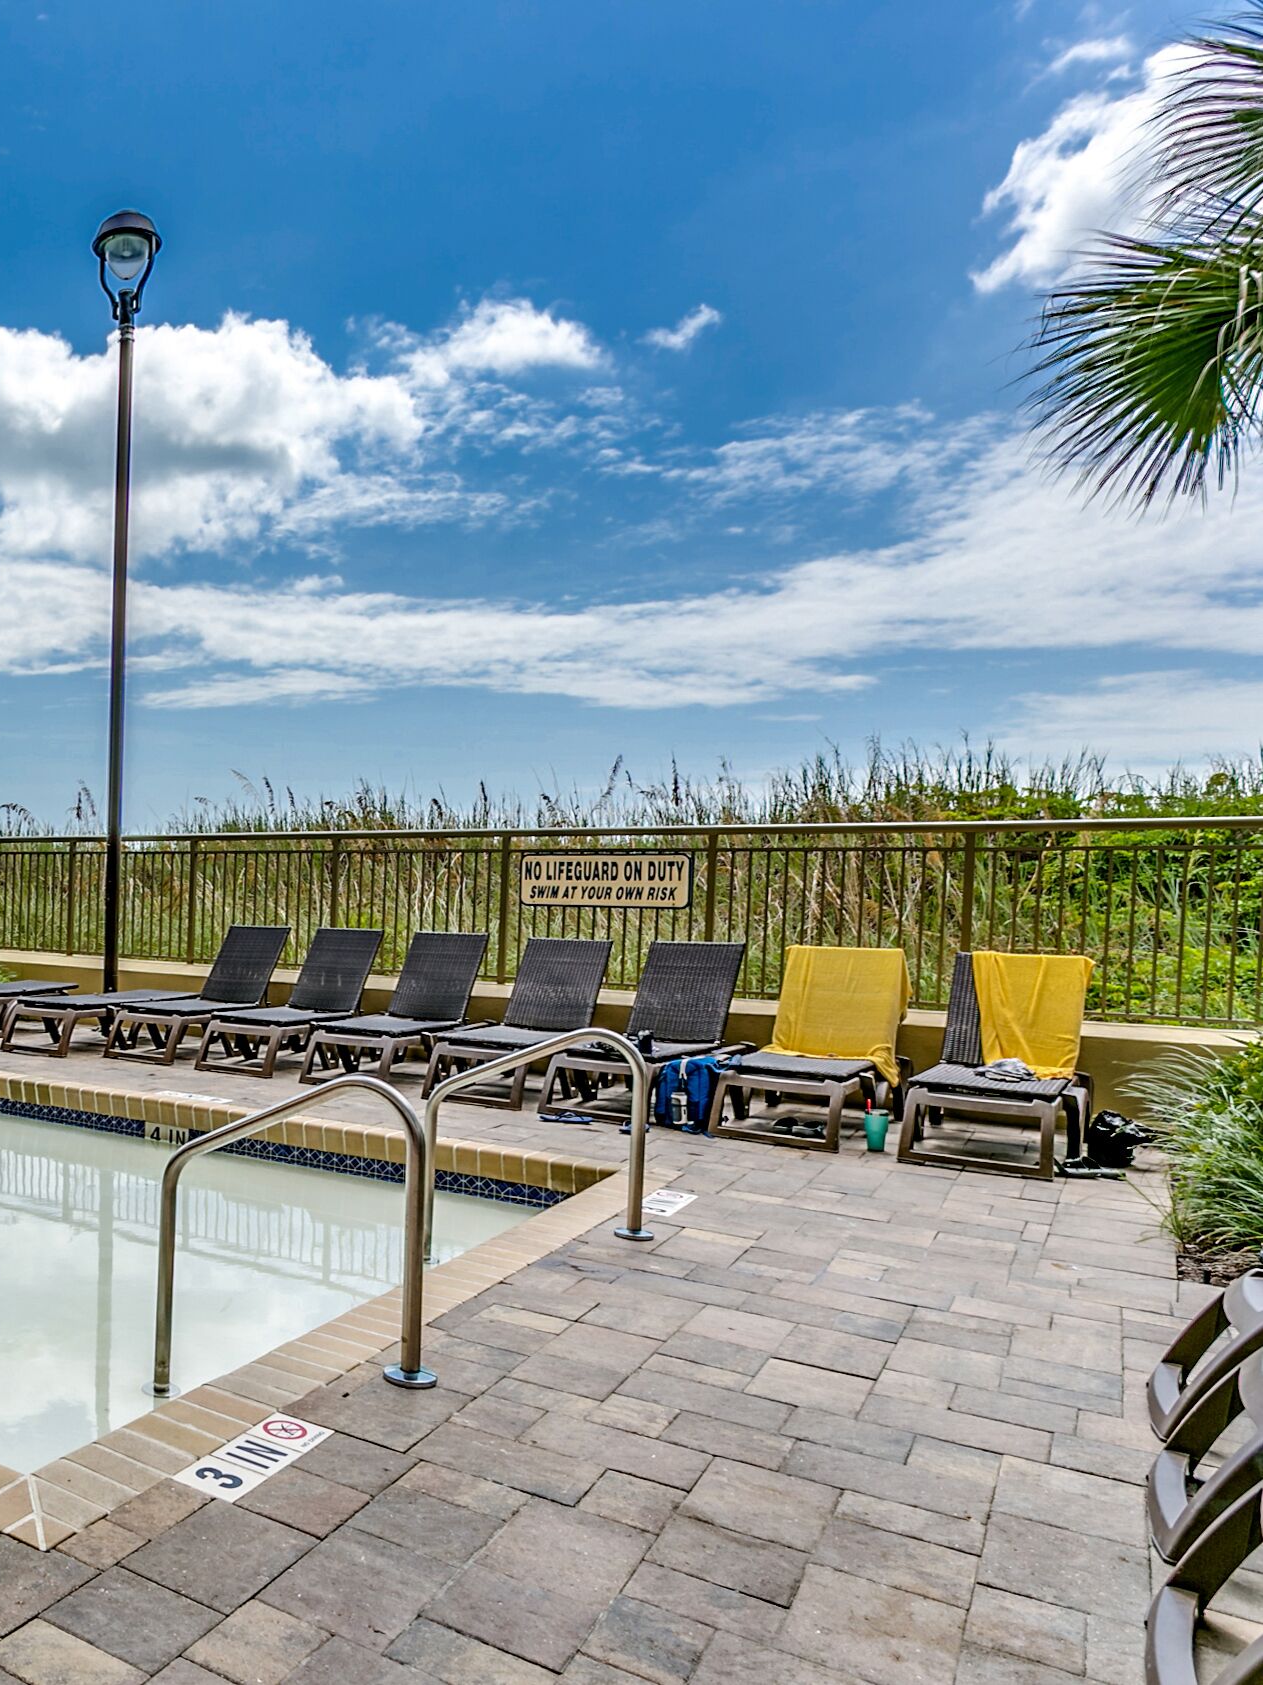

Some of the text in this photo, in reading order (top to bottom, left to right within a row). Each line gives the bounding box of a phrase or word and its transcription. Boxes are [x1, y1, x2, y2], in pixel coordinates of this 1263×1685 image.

[524, 861, 685, 882] NO LIFEGUARD ON DUTY
[529, 885, 678, 901] SWIM AT YOUR OWN RISK
[150, 1126, 186, 1145] 4 IN
[195, 1439, 289, 1490] 3 IN
